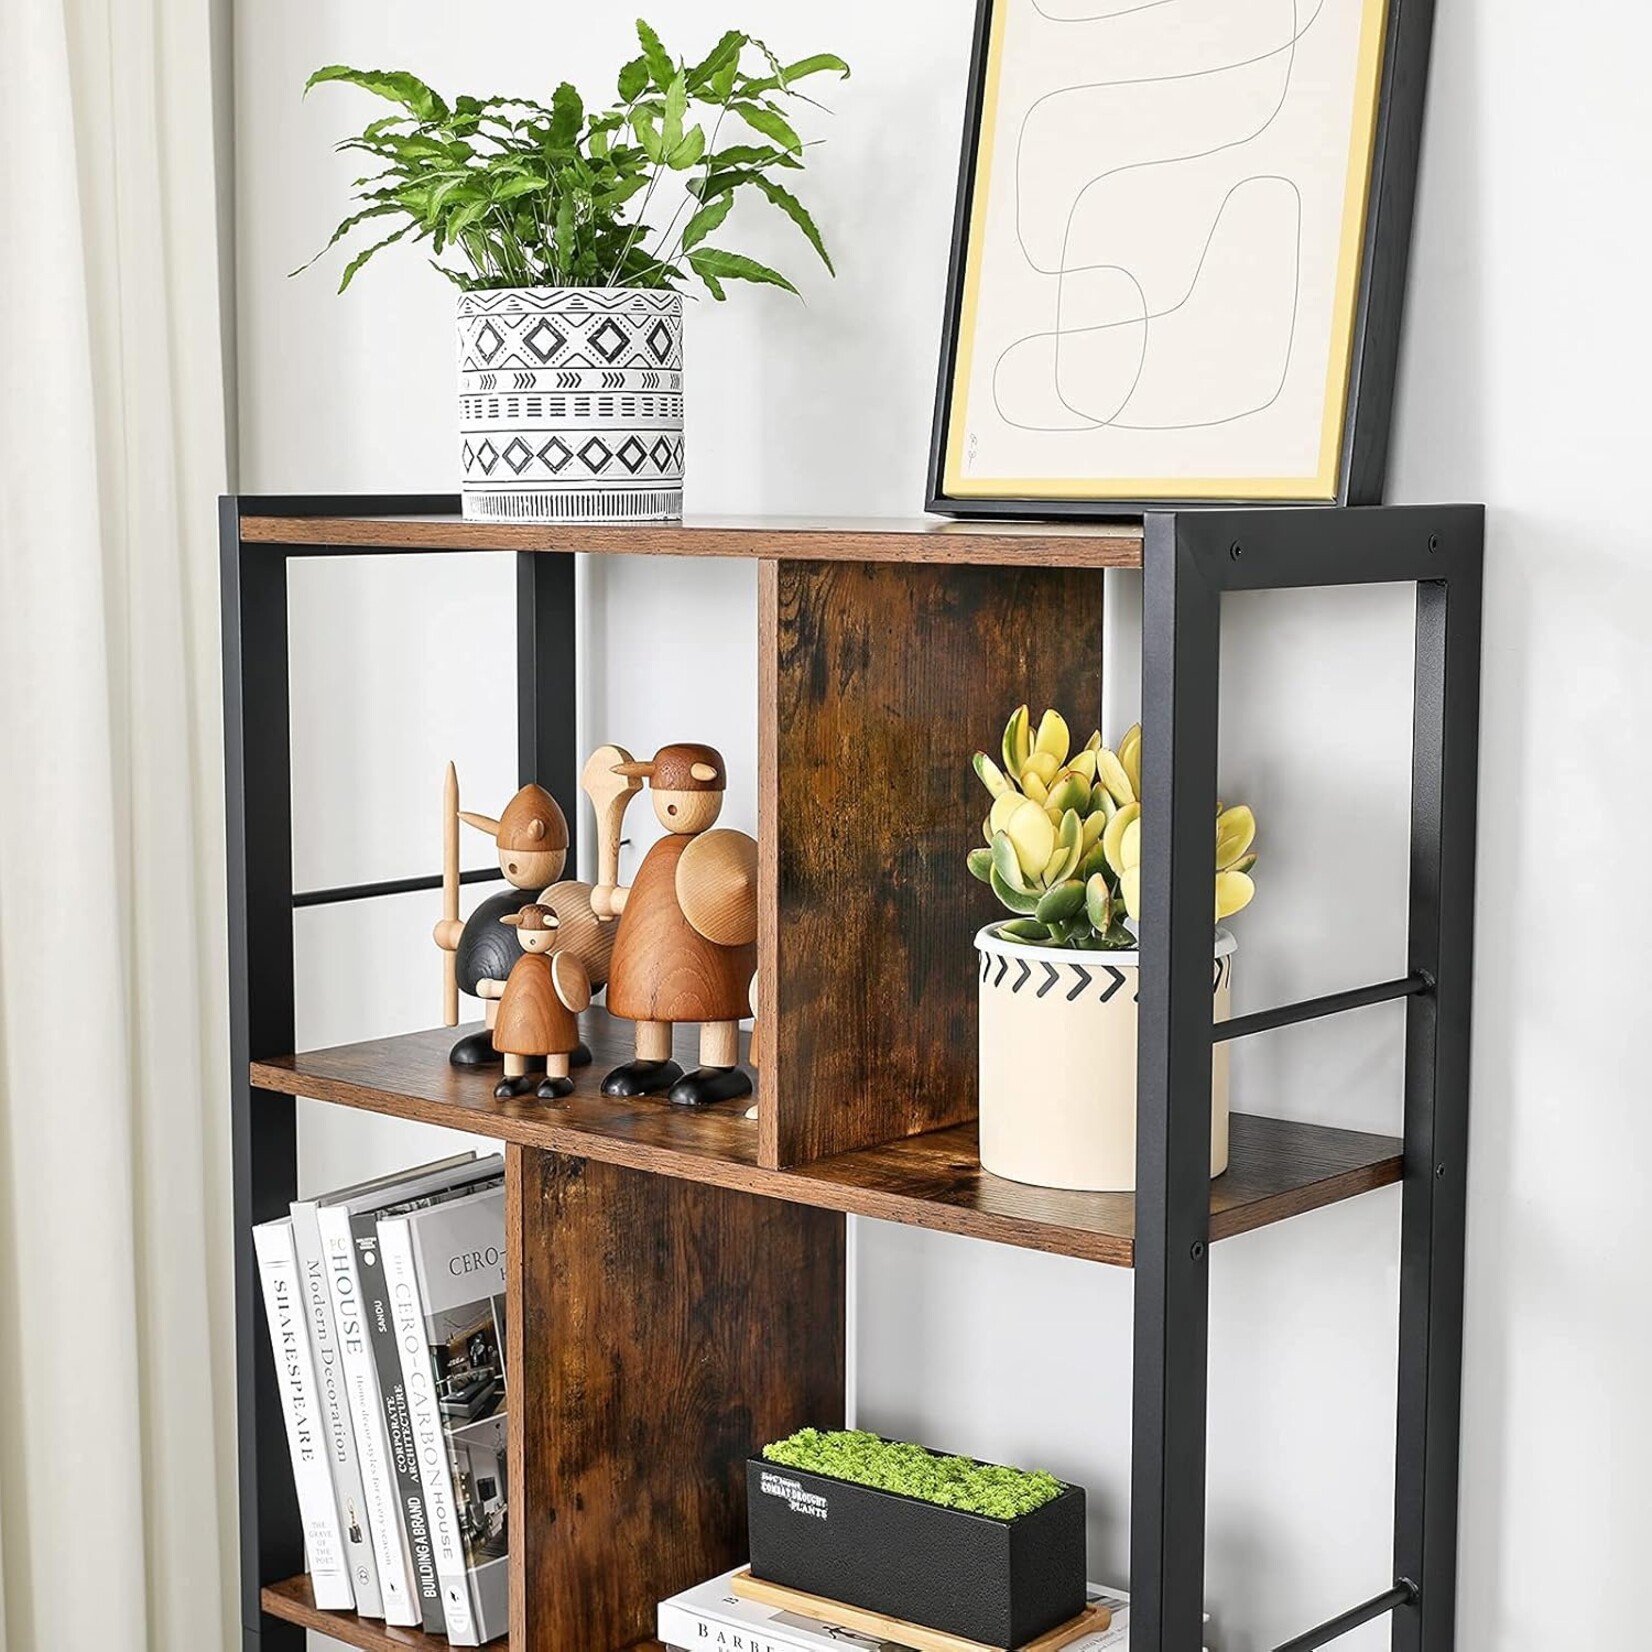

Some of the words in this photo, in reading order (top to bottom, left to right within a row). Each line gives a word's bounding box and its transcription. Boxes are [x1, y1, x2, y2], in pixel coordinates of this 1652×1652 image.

[332, 1256, 364, 1354] HOUSE
[373, 1300, 388, 1333] SANDU
[273, 1279, 314, 1462] SHAKESPEARE
[307, 1260, 328, 1340] Modern
[321, 1349, 347, 1462] Decoration
[356, 1375, 366, 1406] Home
[366, 1443, 378, 1475] styles
[372, 1477, 380, 1493] for
[386, 1396, 407, 1473] CORPORATE
[393, 1384, 420, 1483] ARCHITECTURE
[395, 1283, 444, 1487] CERO-CARBON
[433, 1492, 453, 1560] HOUSE
